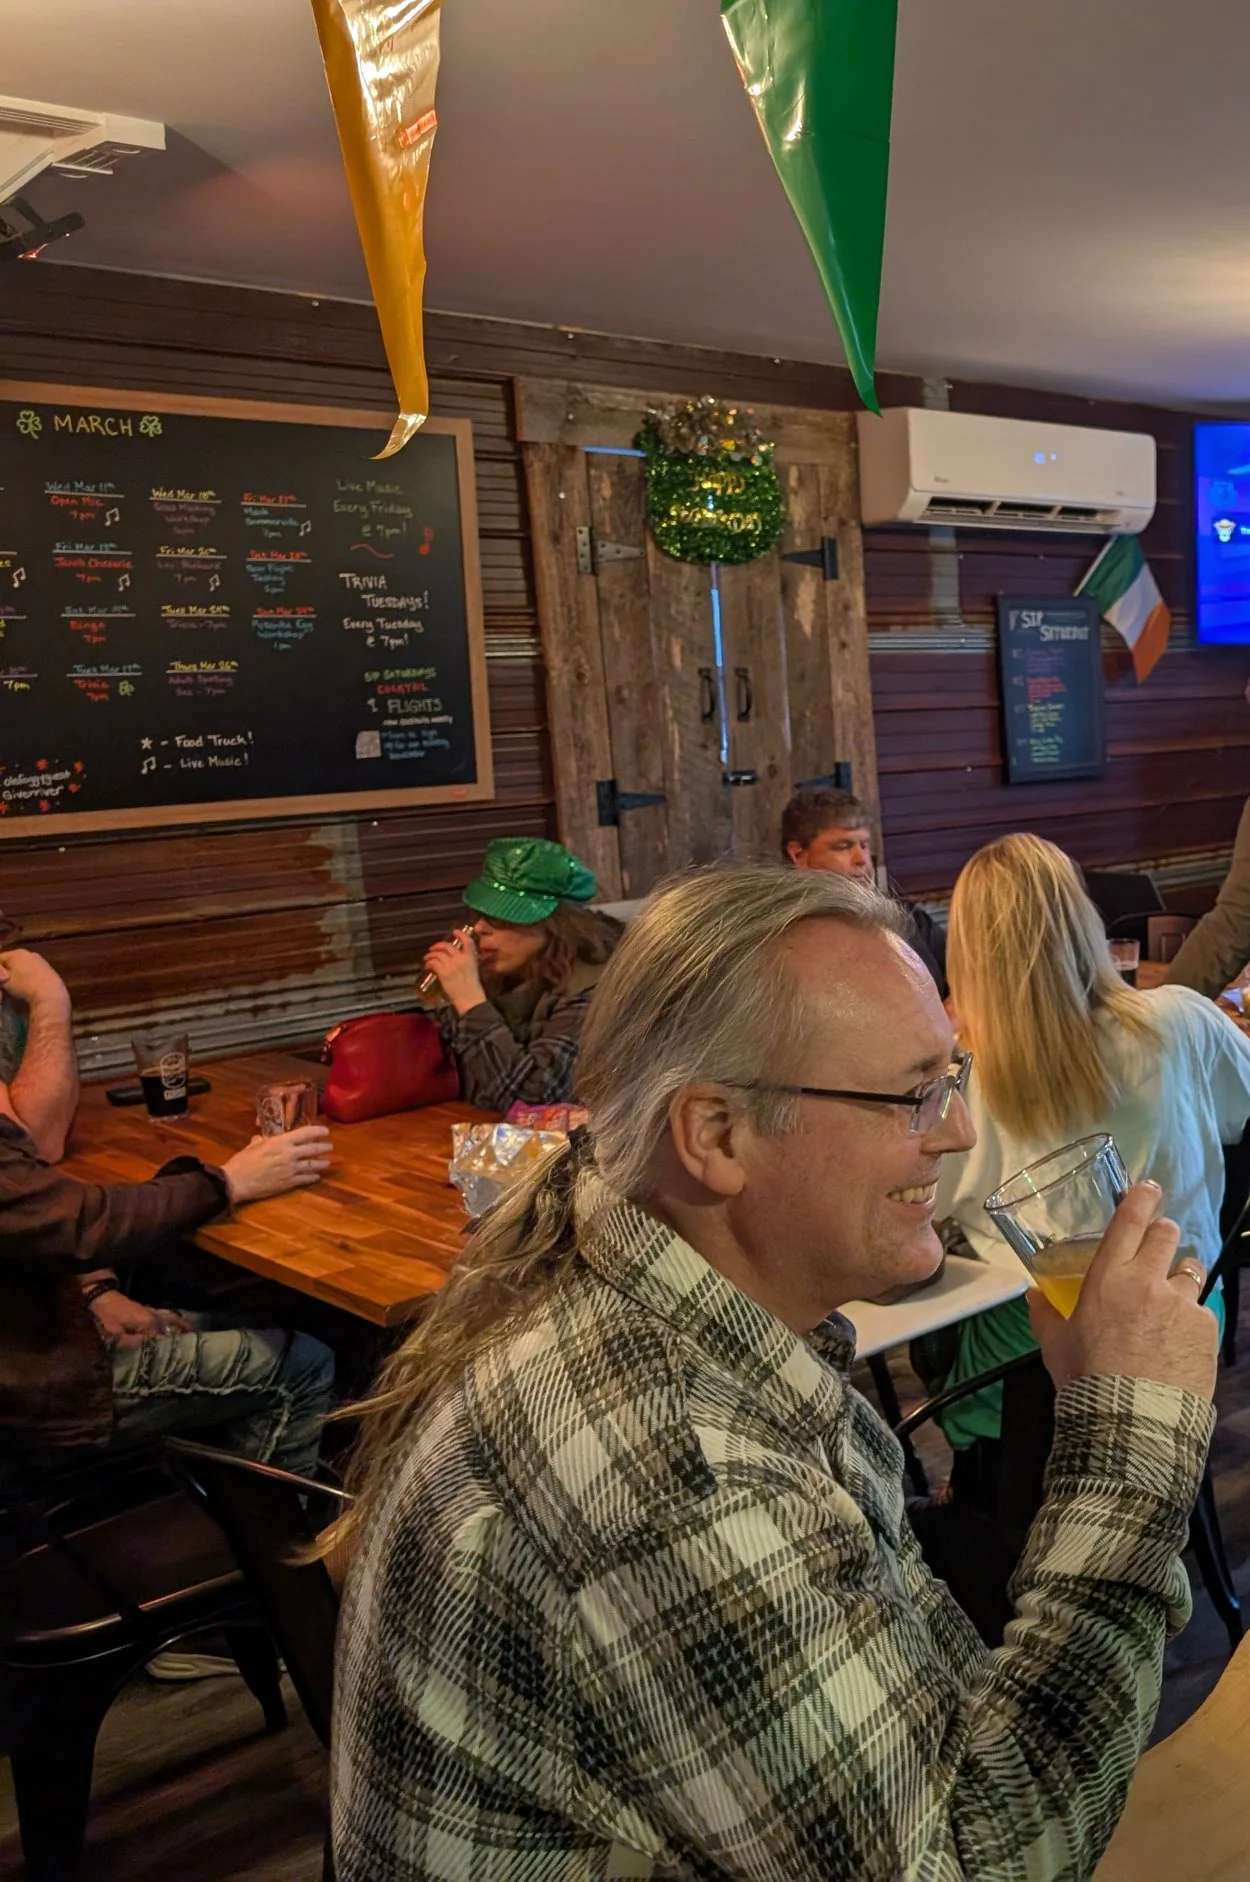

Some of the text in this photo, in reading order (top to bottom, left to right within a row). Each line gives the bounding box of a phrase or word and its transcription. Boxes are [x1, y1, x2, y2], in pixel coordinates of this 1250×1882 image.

[54, 414, 134, 437] MARCH
[46, 481, 71, 491] Wed
[75, 481, 96, 491] Mar
[336, 478, 363, 491] Live
[152, 486, 174, 498] Wed
[177, 489, 195, 499] Mar
[51, 496, 78, 507] Open
[333, 500, 413, 519] Every Friday
[178, 547, 195, 555] Mar
[339, 573, 387, 590] TRIVIA
[188, 605, 205, 614] Mar
[70, 620, 106, 632] Bingo
[342, 617, 425, 634] Every Tuesday
[200, 662, 216, 671] Mar
[387, 697, 442, 713] FLIGHTS
[174, 735, 203, 748] Food
[207, 731, 253, 747] Truck!
[180, 756, 204, 768] Live
[208, 752, 249, 767] Music!
